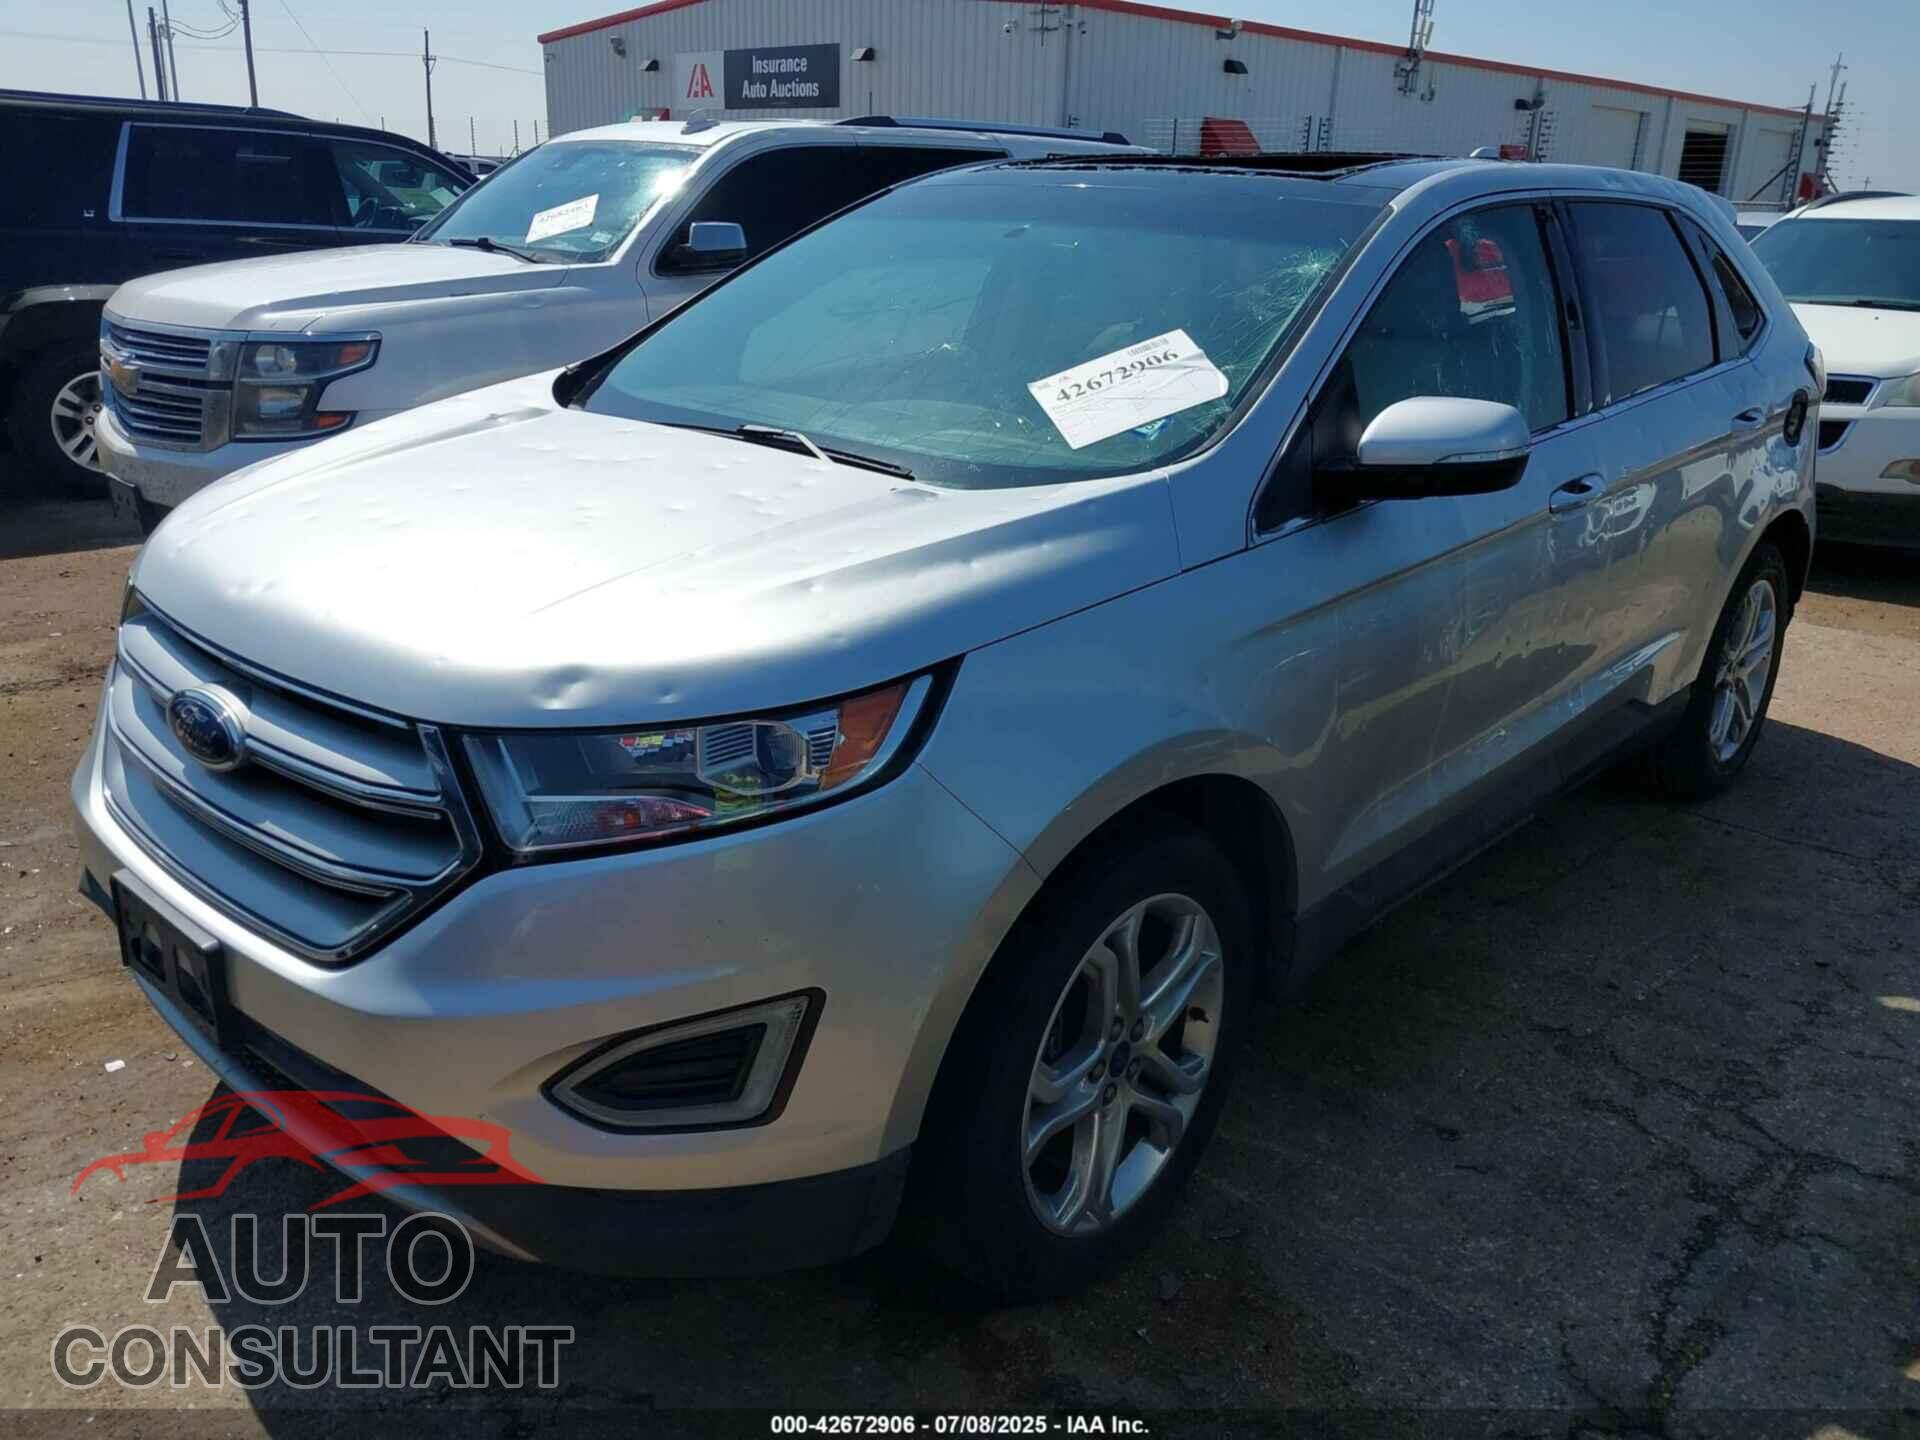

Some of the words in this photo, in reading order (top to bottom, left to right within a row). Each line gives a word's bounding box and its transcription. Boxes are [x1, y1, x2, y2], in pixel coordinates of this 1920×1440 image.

[752, 56, 808, 74] Insurance
[742, 80, 767, 99] Auto
[770, 78, 819, 98] Auctions
[1056, 348, 1179, 403] 42672906
